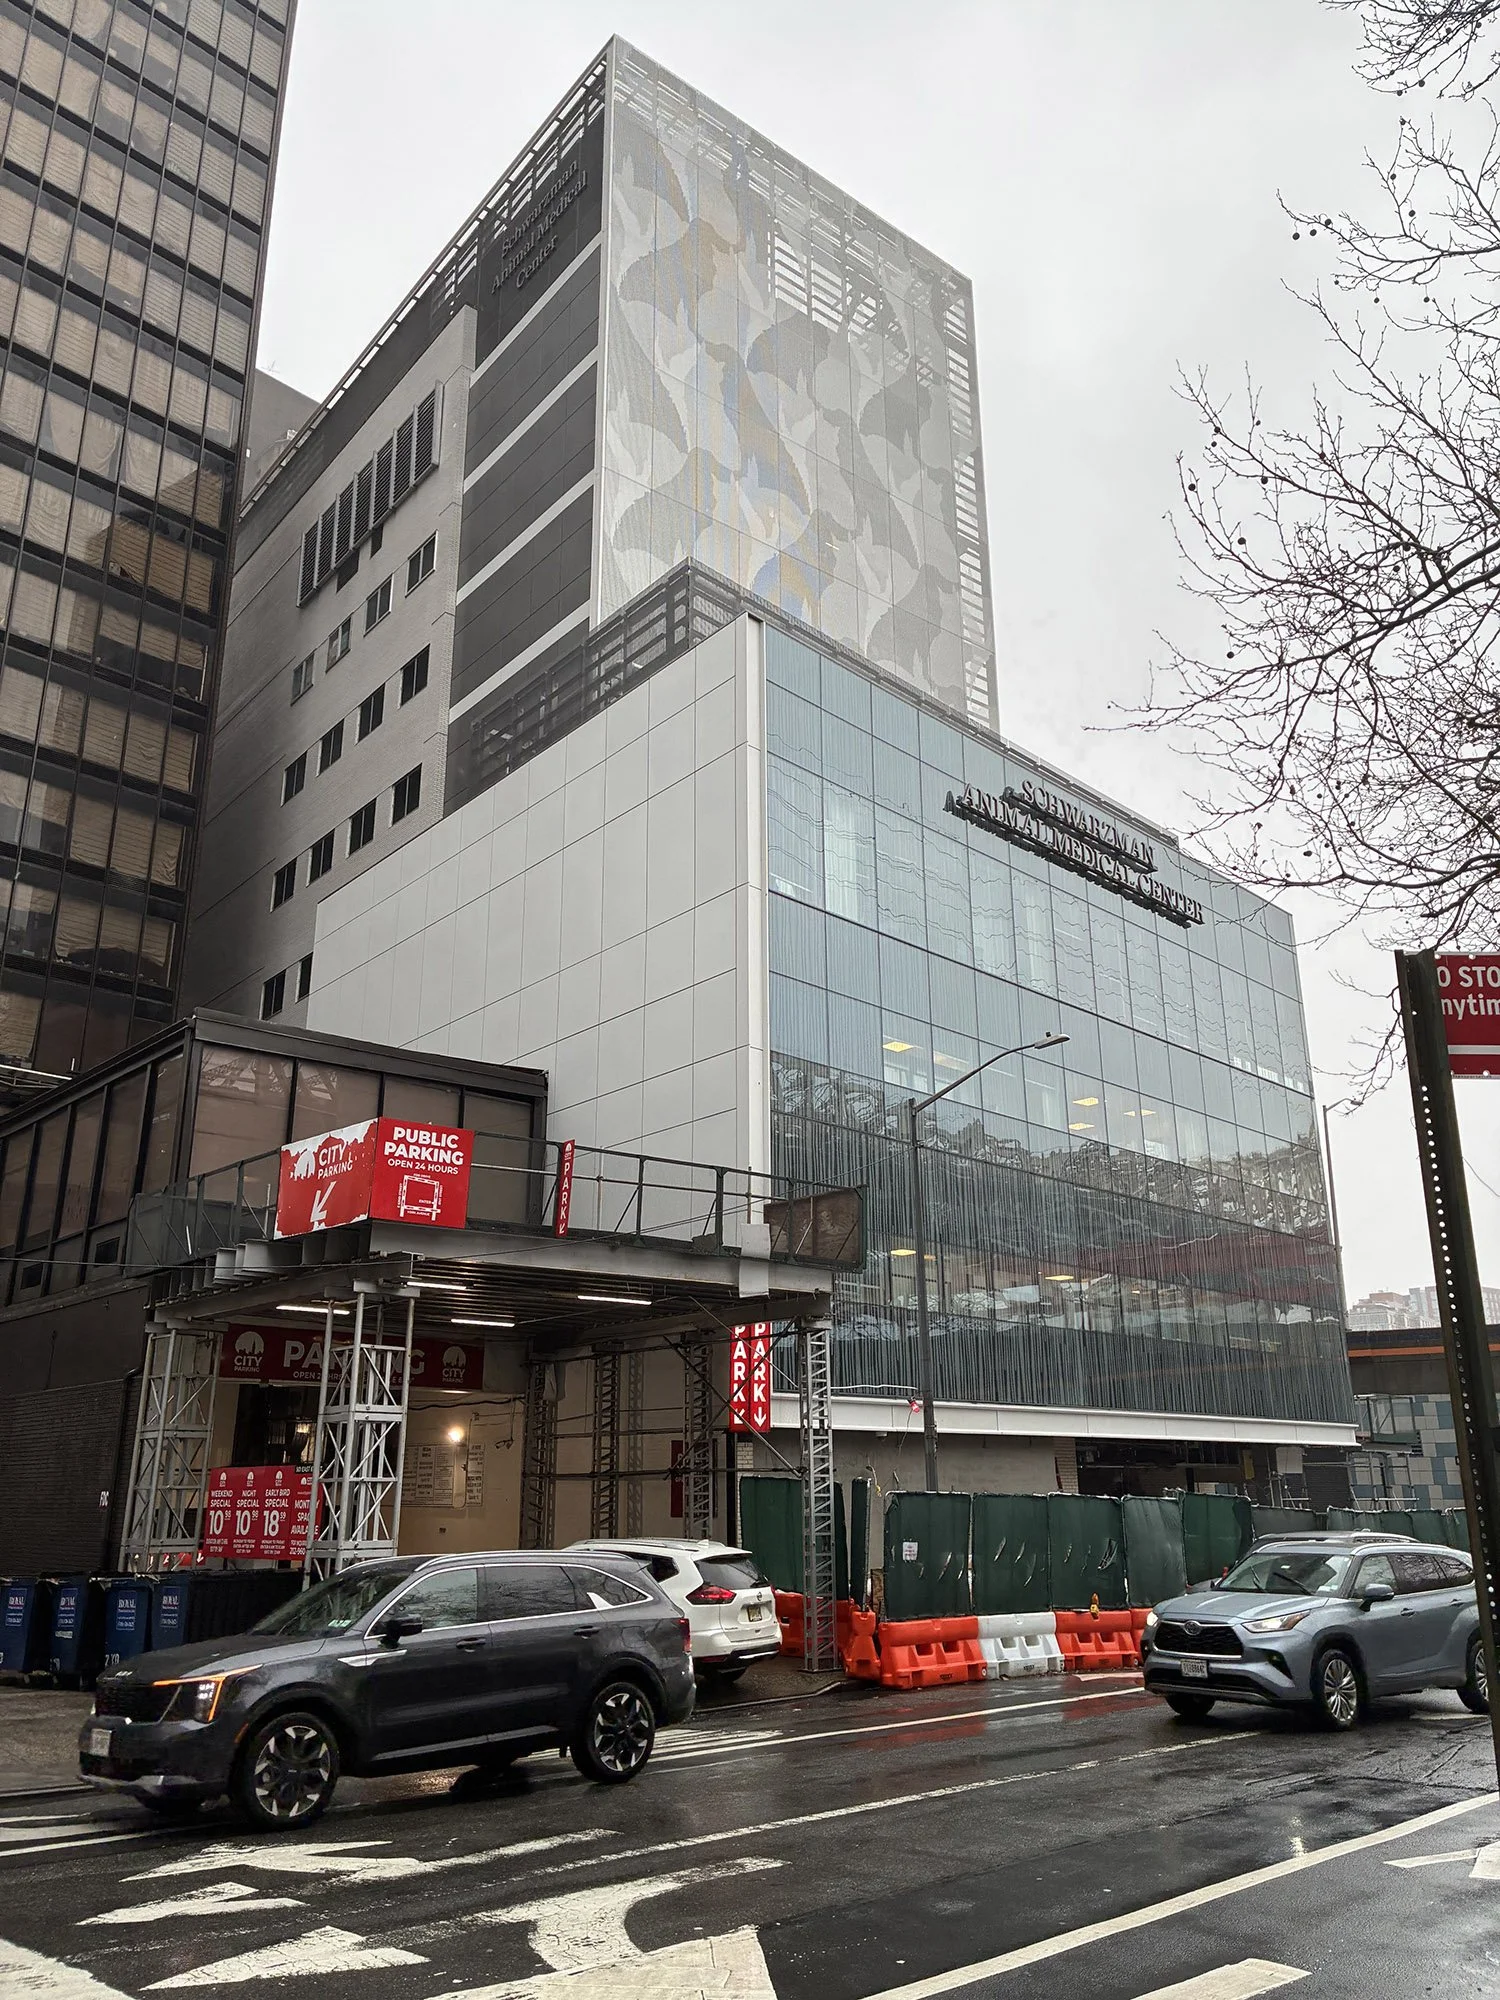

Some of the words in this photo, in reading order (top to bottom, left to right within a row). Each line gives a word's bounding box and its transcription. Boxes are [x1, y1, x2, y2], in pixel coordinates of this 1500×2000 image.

[501, 159, 578, 258] Schwarzman
[491, 236, 536, 294] Animal
[537, 170, 588, 241] Medical
[515, 235, 559, 289] Center
[1022, 779, 1155, 868] SCHWARZMAN
[963, 783, 1049, 849] ANIMAL
[1049, 829, 1137, 888] MEDICAL
[1136, 873, 1205, 925] CENTER
[1437, 965, 1451, 988] O
[1440, 993, 1500, 1021] nytim
[393, 1127, 459, 1149] PUBLIC
[319, 1144, 346, 1167] CITY
[384, 1141, 464, 1165] PARKING
[317, 1160, 353, 1180] PARKING
[387, 1158, 414, 1169] OPEN
[415, 1162, 426, 1170] 24
[427, 1164, 459, 1175] HOURS
[560, 1162, 571, 1220] PARK
[233, 1365, 261, 1373] PARKING
[234, 1355, 263, 1367] CITY
[732, 1325, 748, 1402] PARK
[752, 1321, 767, 1402] PARK
[293, 1371, 316, 1380] OPEN
[442, 1368, 466, 1378] CITY
[210, 1500, 231, 1508] SPECIAL
[236, 1500, 260, 1508] SPECIAL
[265, 1489, 279, 1497] EARLY
[265, 1499, 289, 1507] SPECIAL
[209, 1510, 224, 1535] 10
[236, 1510, 251, 1536] 10
[263, 1510, 279, 1537] 18
